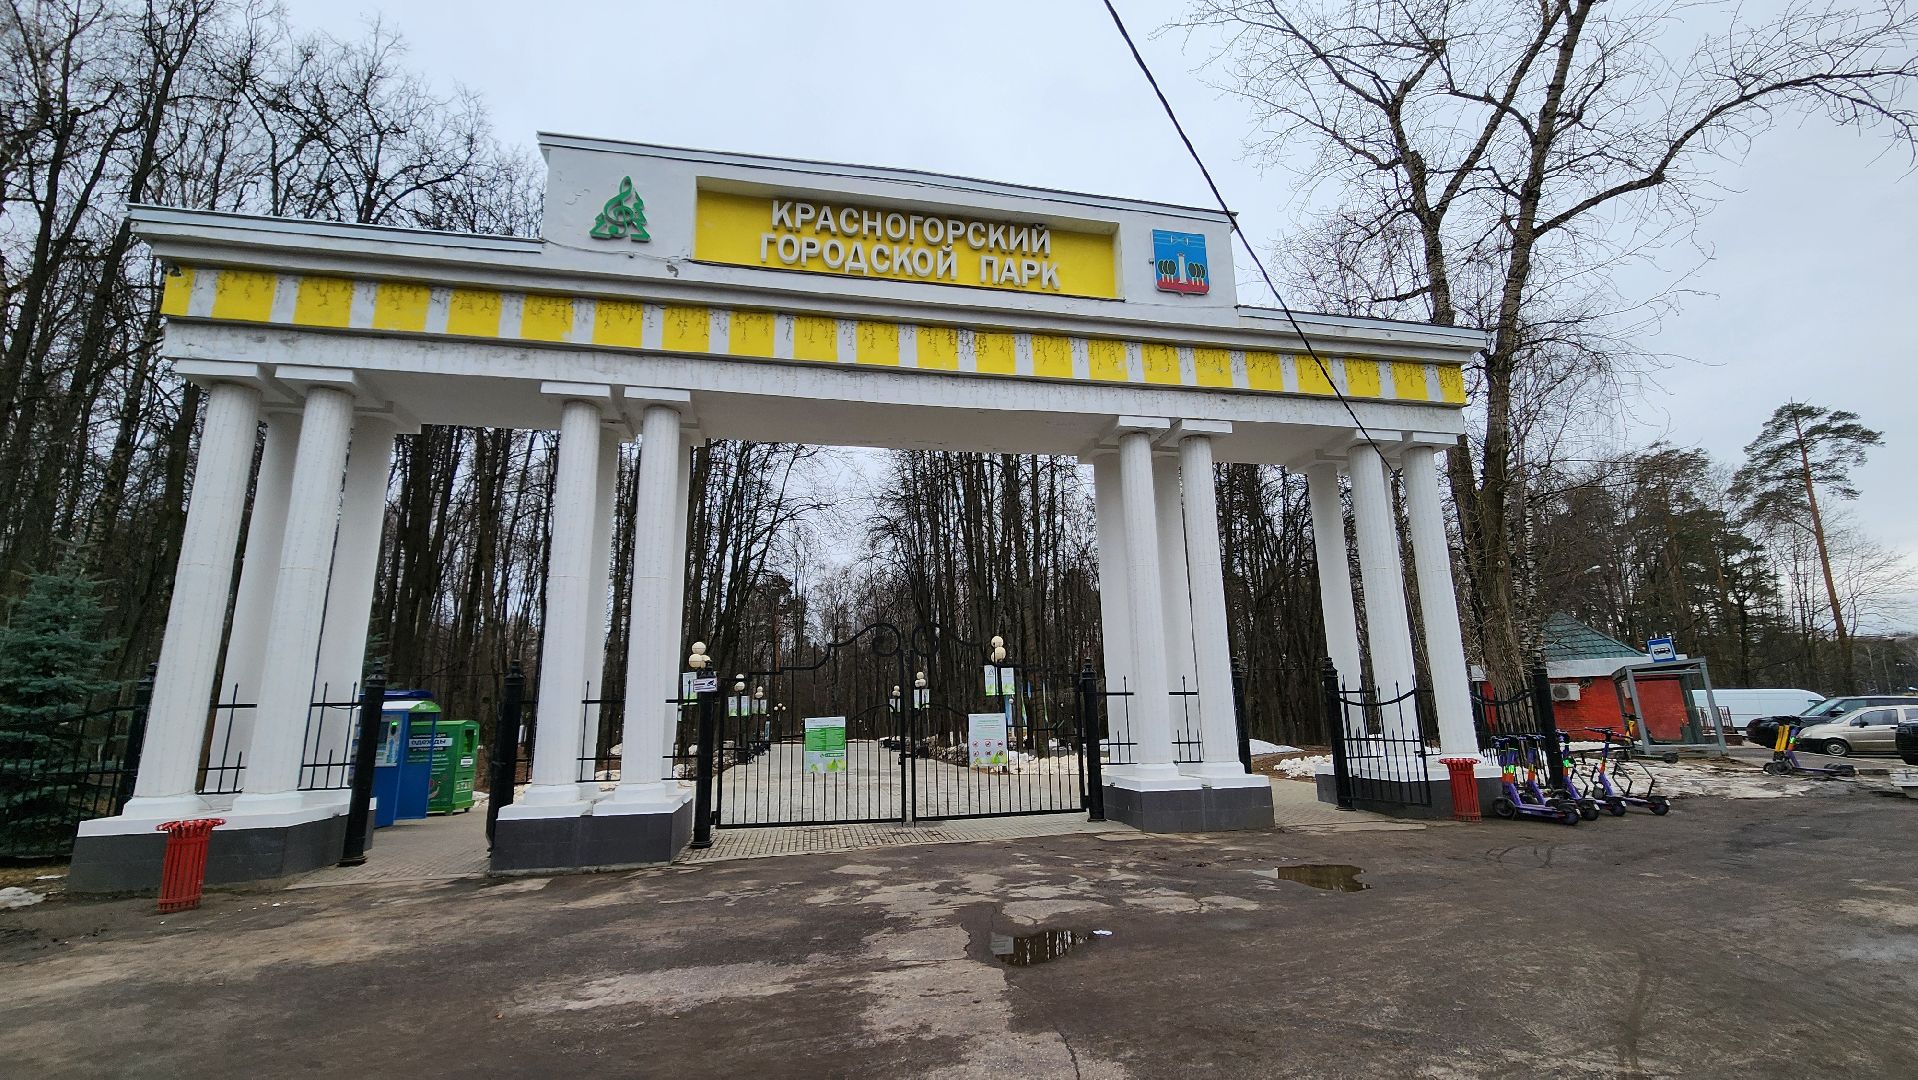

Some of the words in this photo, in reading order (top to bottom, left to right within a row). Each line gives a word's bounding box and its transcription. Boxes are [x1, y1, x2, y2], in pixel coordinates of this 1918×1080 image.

[772, 200, 1051, 258] КРАСНОГОРСКИЙ
[760, 232, 957, 278] ГОРОДСКОЙ
[980, 255, 1060, 290] ПАРК
